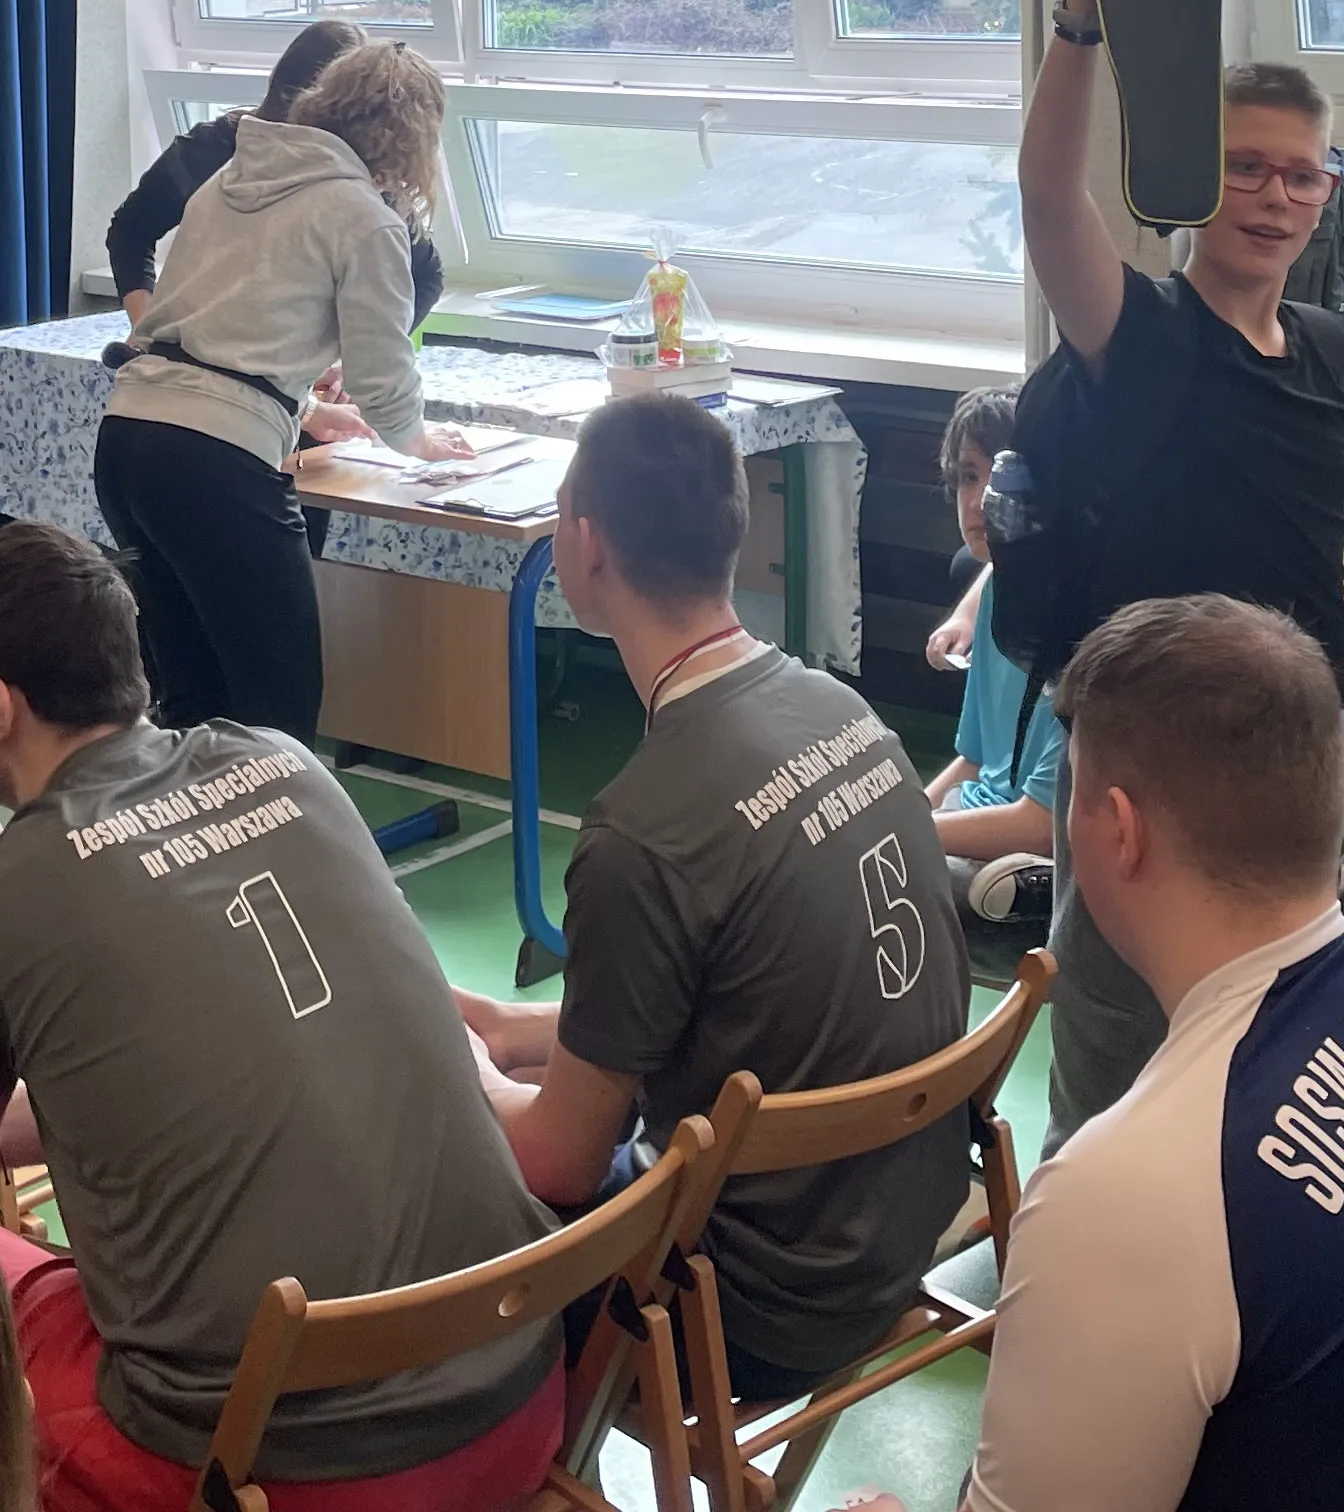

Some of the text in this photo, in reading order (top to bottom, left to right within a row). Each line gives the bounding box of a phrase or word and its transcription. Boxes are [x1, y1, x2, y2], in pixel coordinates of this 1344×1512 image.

[188, 748, 307, 810] Specjalnych
[800, 758, 903, 846] nr 105 Warszawa
[139, 796, 303, 878] nr 105 Warszawa
[226, 871, 332, 1019] 1
[859, 832, 925, 999] 5
